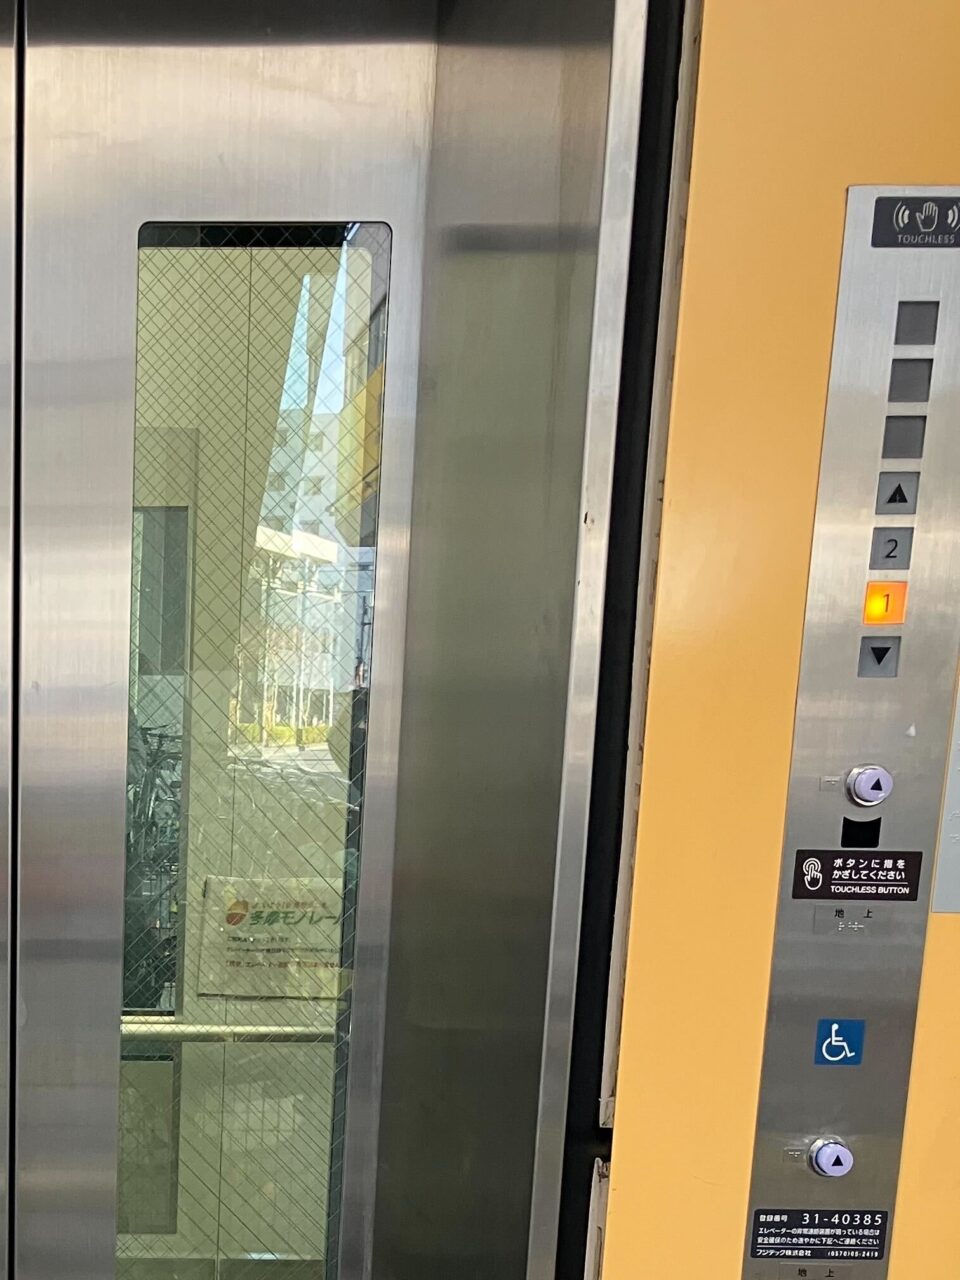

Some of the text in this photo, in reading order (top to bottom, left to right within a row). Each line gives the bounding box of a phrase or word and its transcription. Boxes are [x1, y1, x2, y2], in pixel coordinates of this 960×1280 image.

[897, 233, 956, 244] TOUCHLESS
[885, 538, 898, 559] 2
[882, 593, 890, 613] 1
[833, 858, 906, 869] ボタンに指を
[831, 869, 906, 880] かざしてください
[830, 885, 910, 894] TOUCHLESS BUTTON
[801, 1213, 882, 1226] 31-40385
